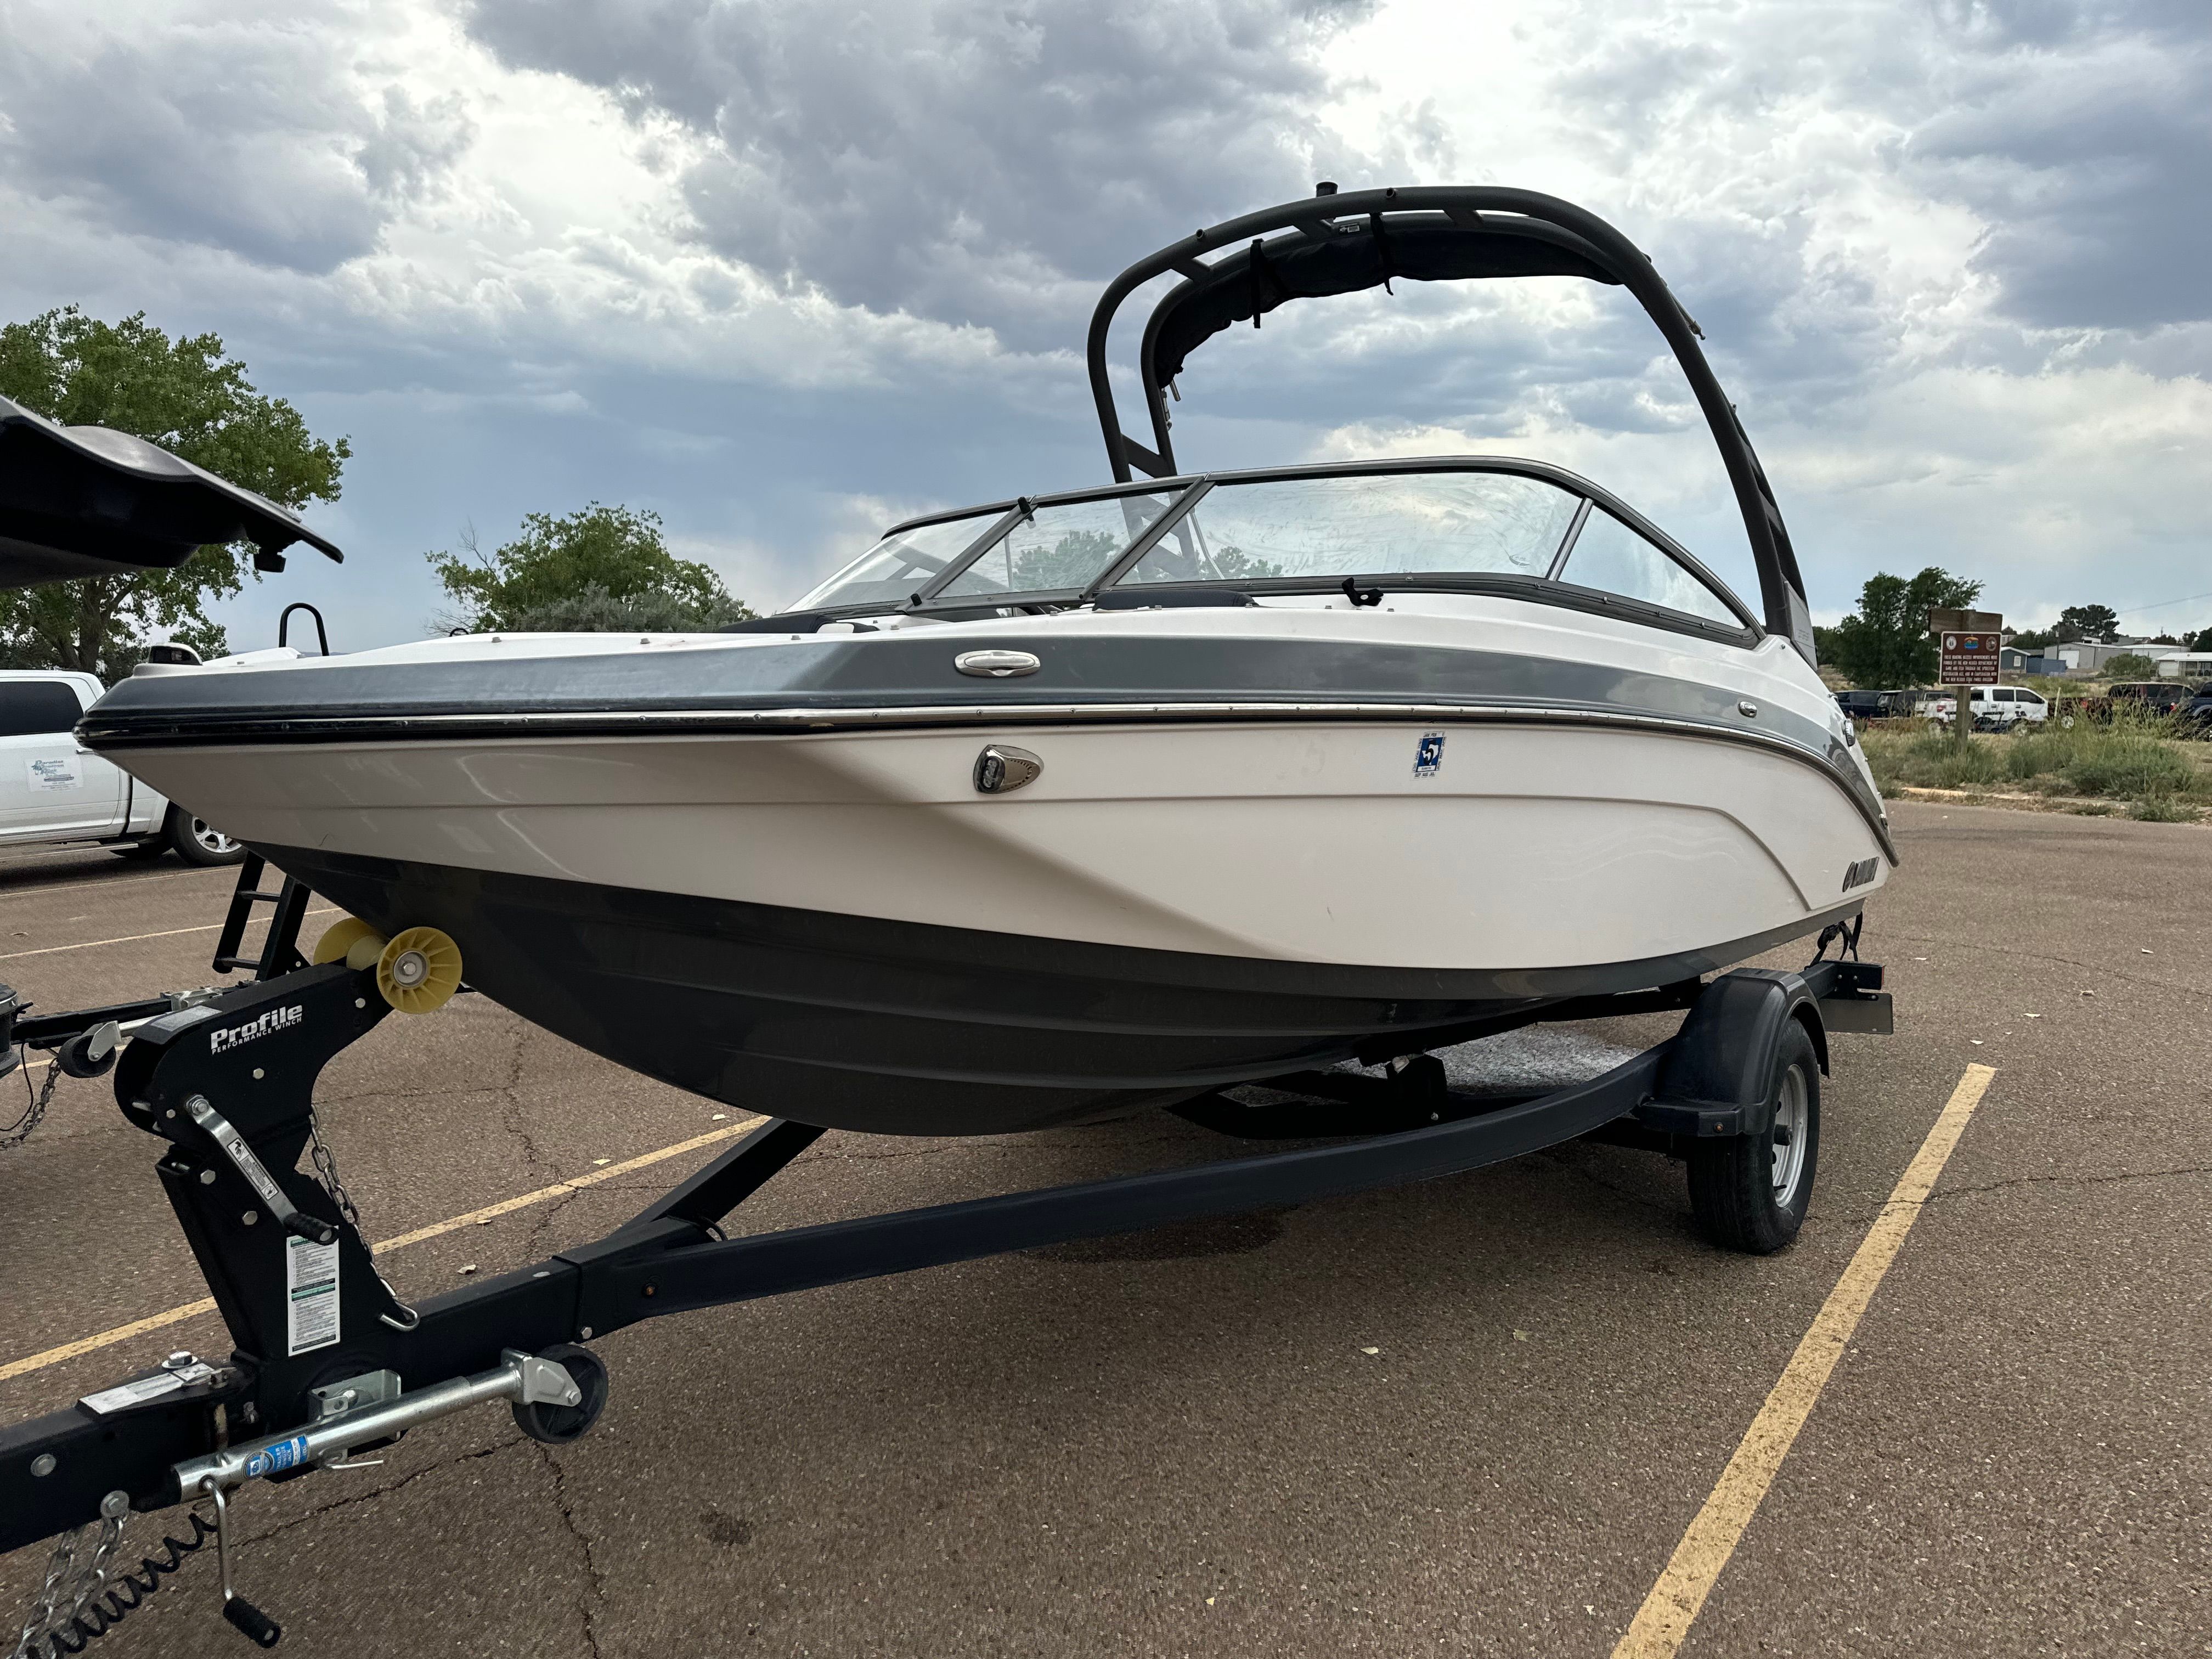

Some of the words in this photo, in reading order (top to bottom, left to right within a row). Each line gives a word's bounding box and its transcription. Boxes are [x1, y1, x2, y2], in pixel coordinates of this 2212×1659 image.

[211, 1005, 302, 1049] Profile
[212, 1028, 272, 1055] PERFORMANCE
[275, 1016, 302, 1031] WINCH
